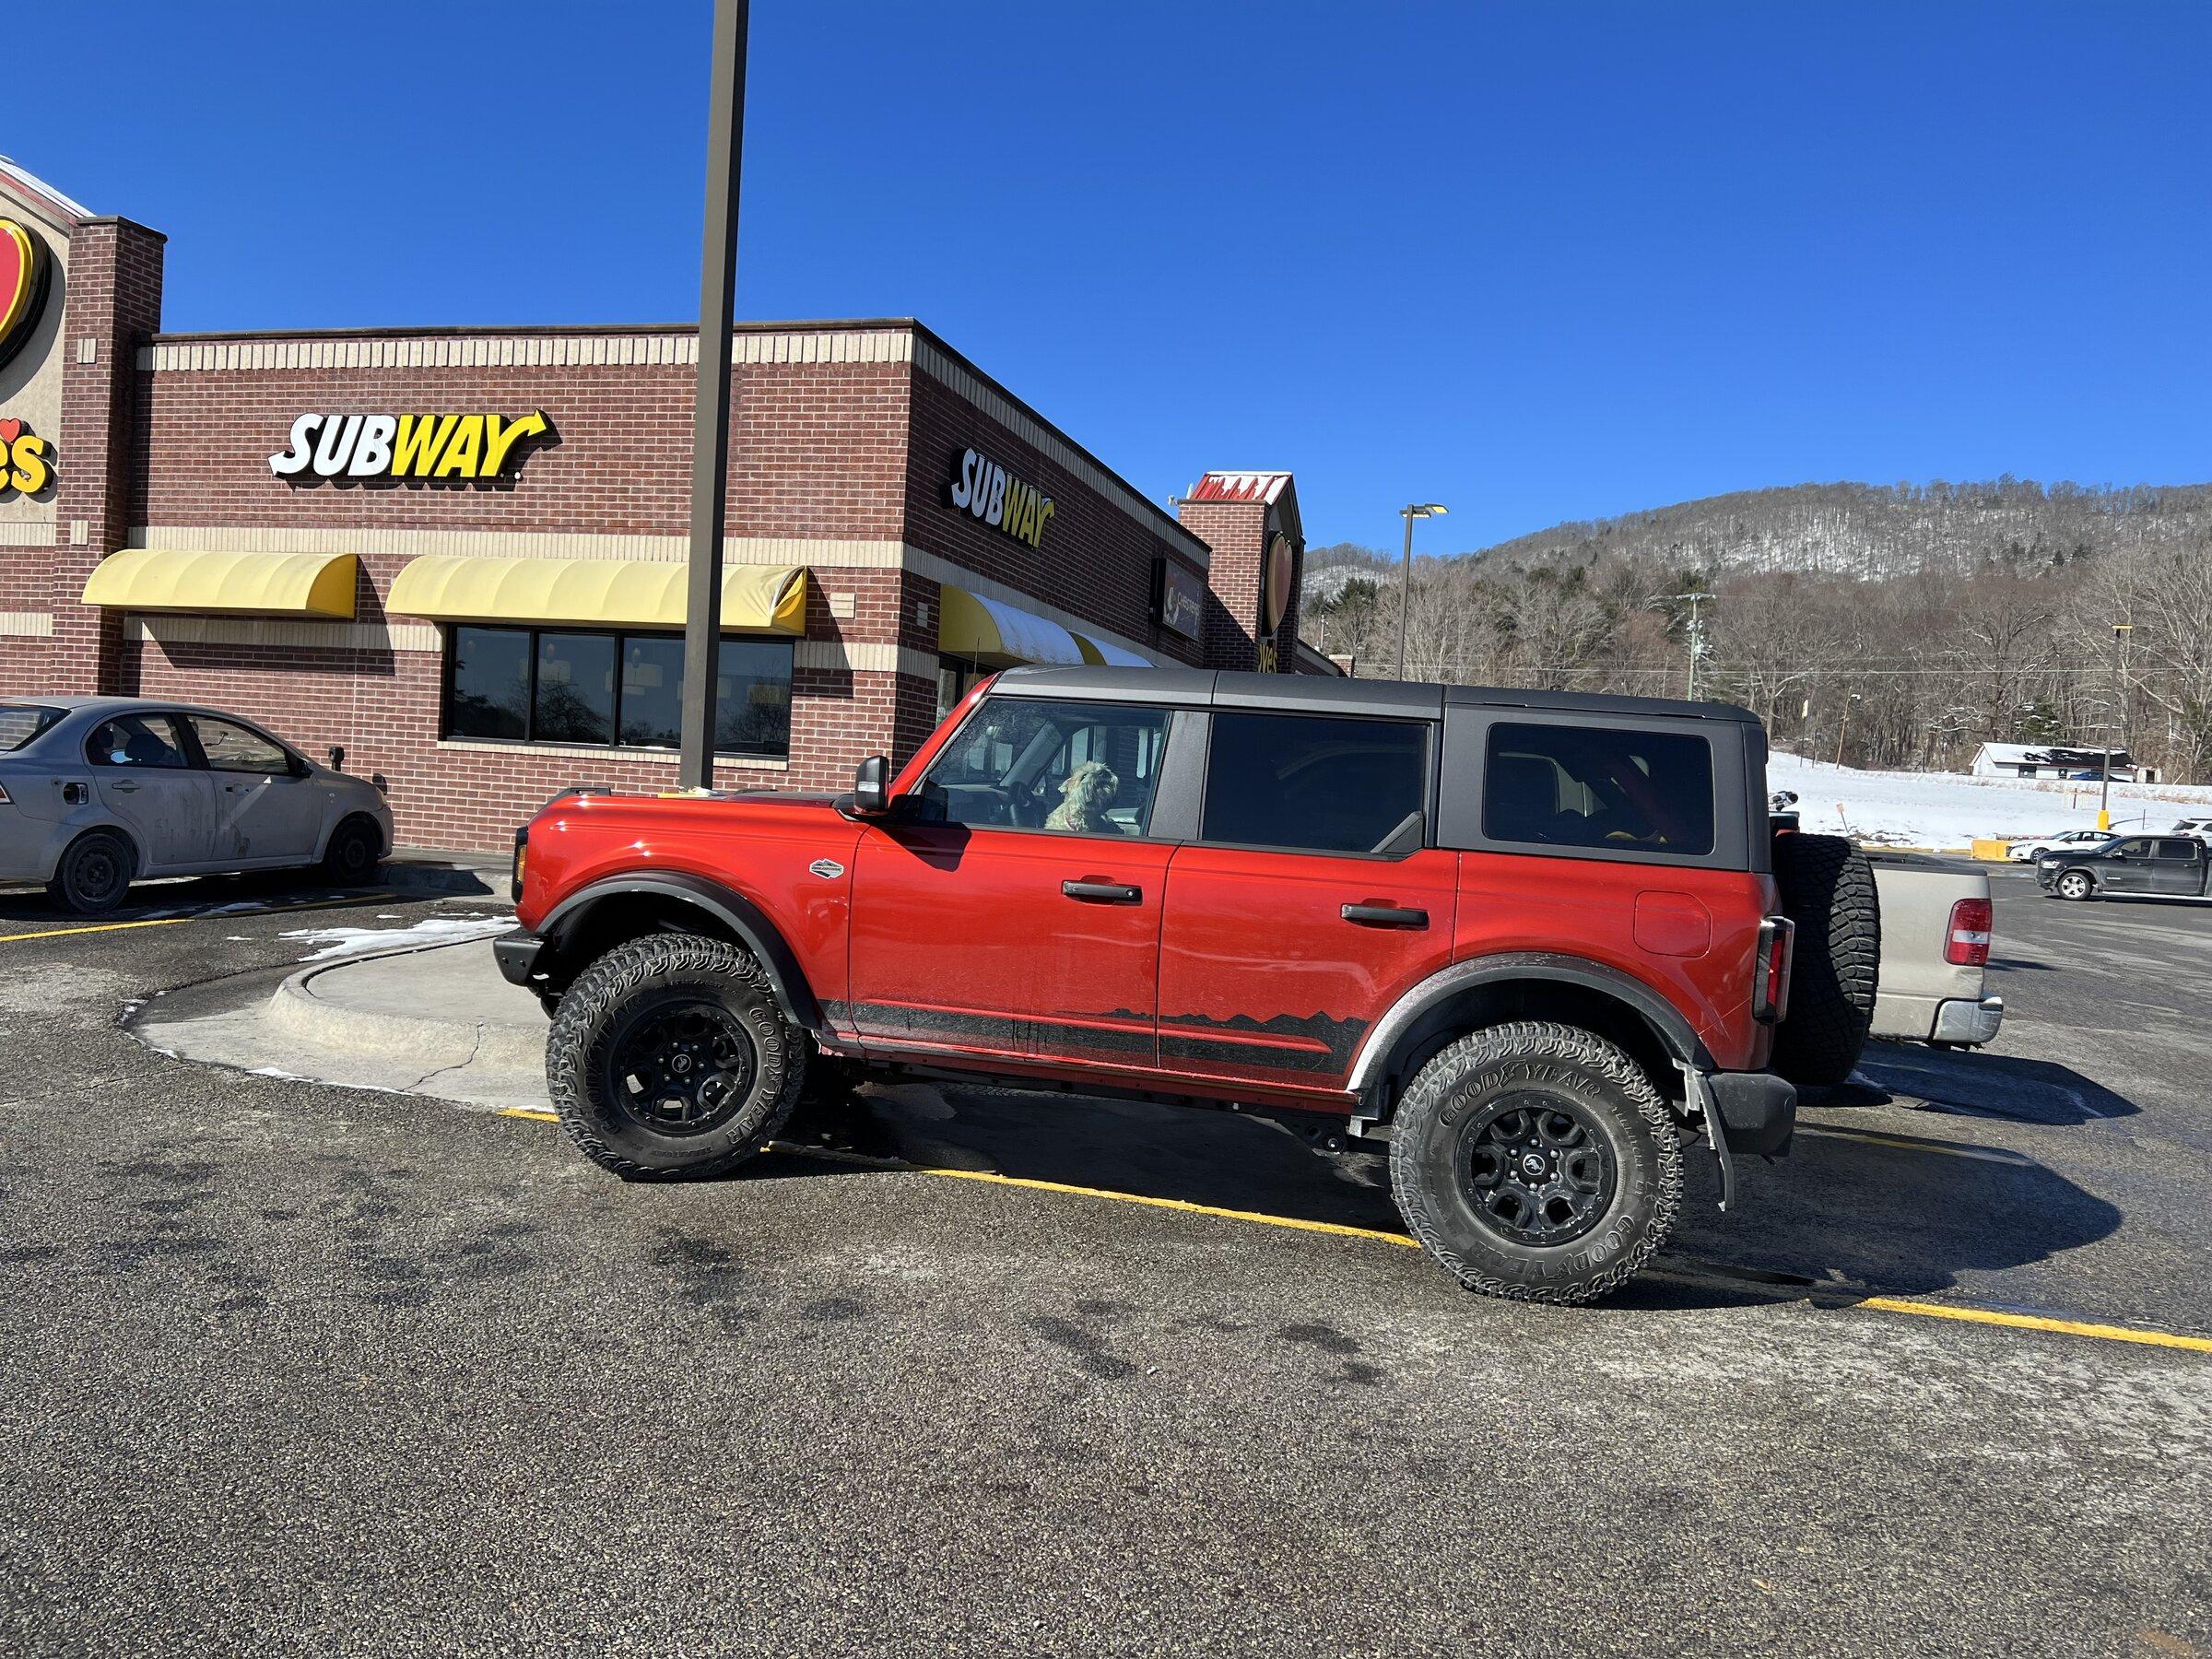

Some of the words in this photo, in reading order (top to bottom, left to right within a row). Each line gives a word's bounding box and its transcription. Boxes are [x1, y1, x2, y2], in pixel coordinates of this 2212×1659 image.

[267, 408, 547, 478] SUBWAY
[951, 447, 1055, 548] SUBWAY
[1439, 1059, 1601, 1127] GOODYEAR
